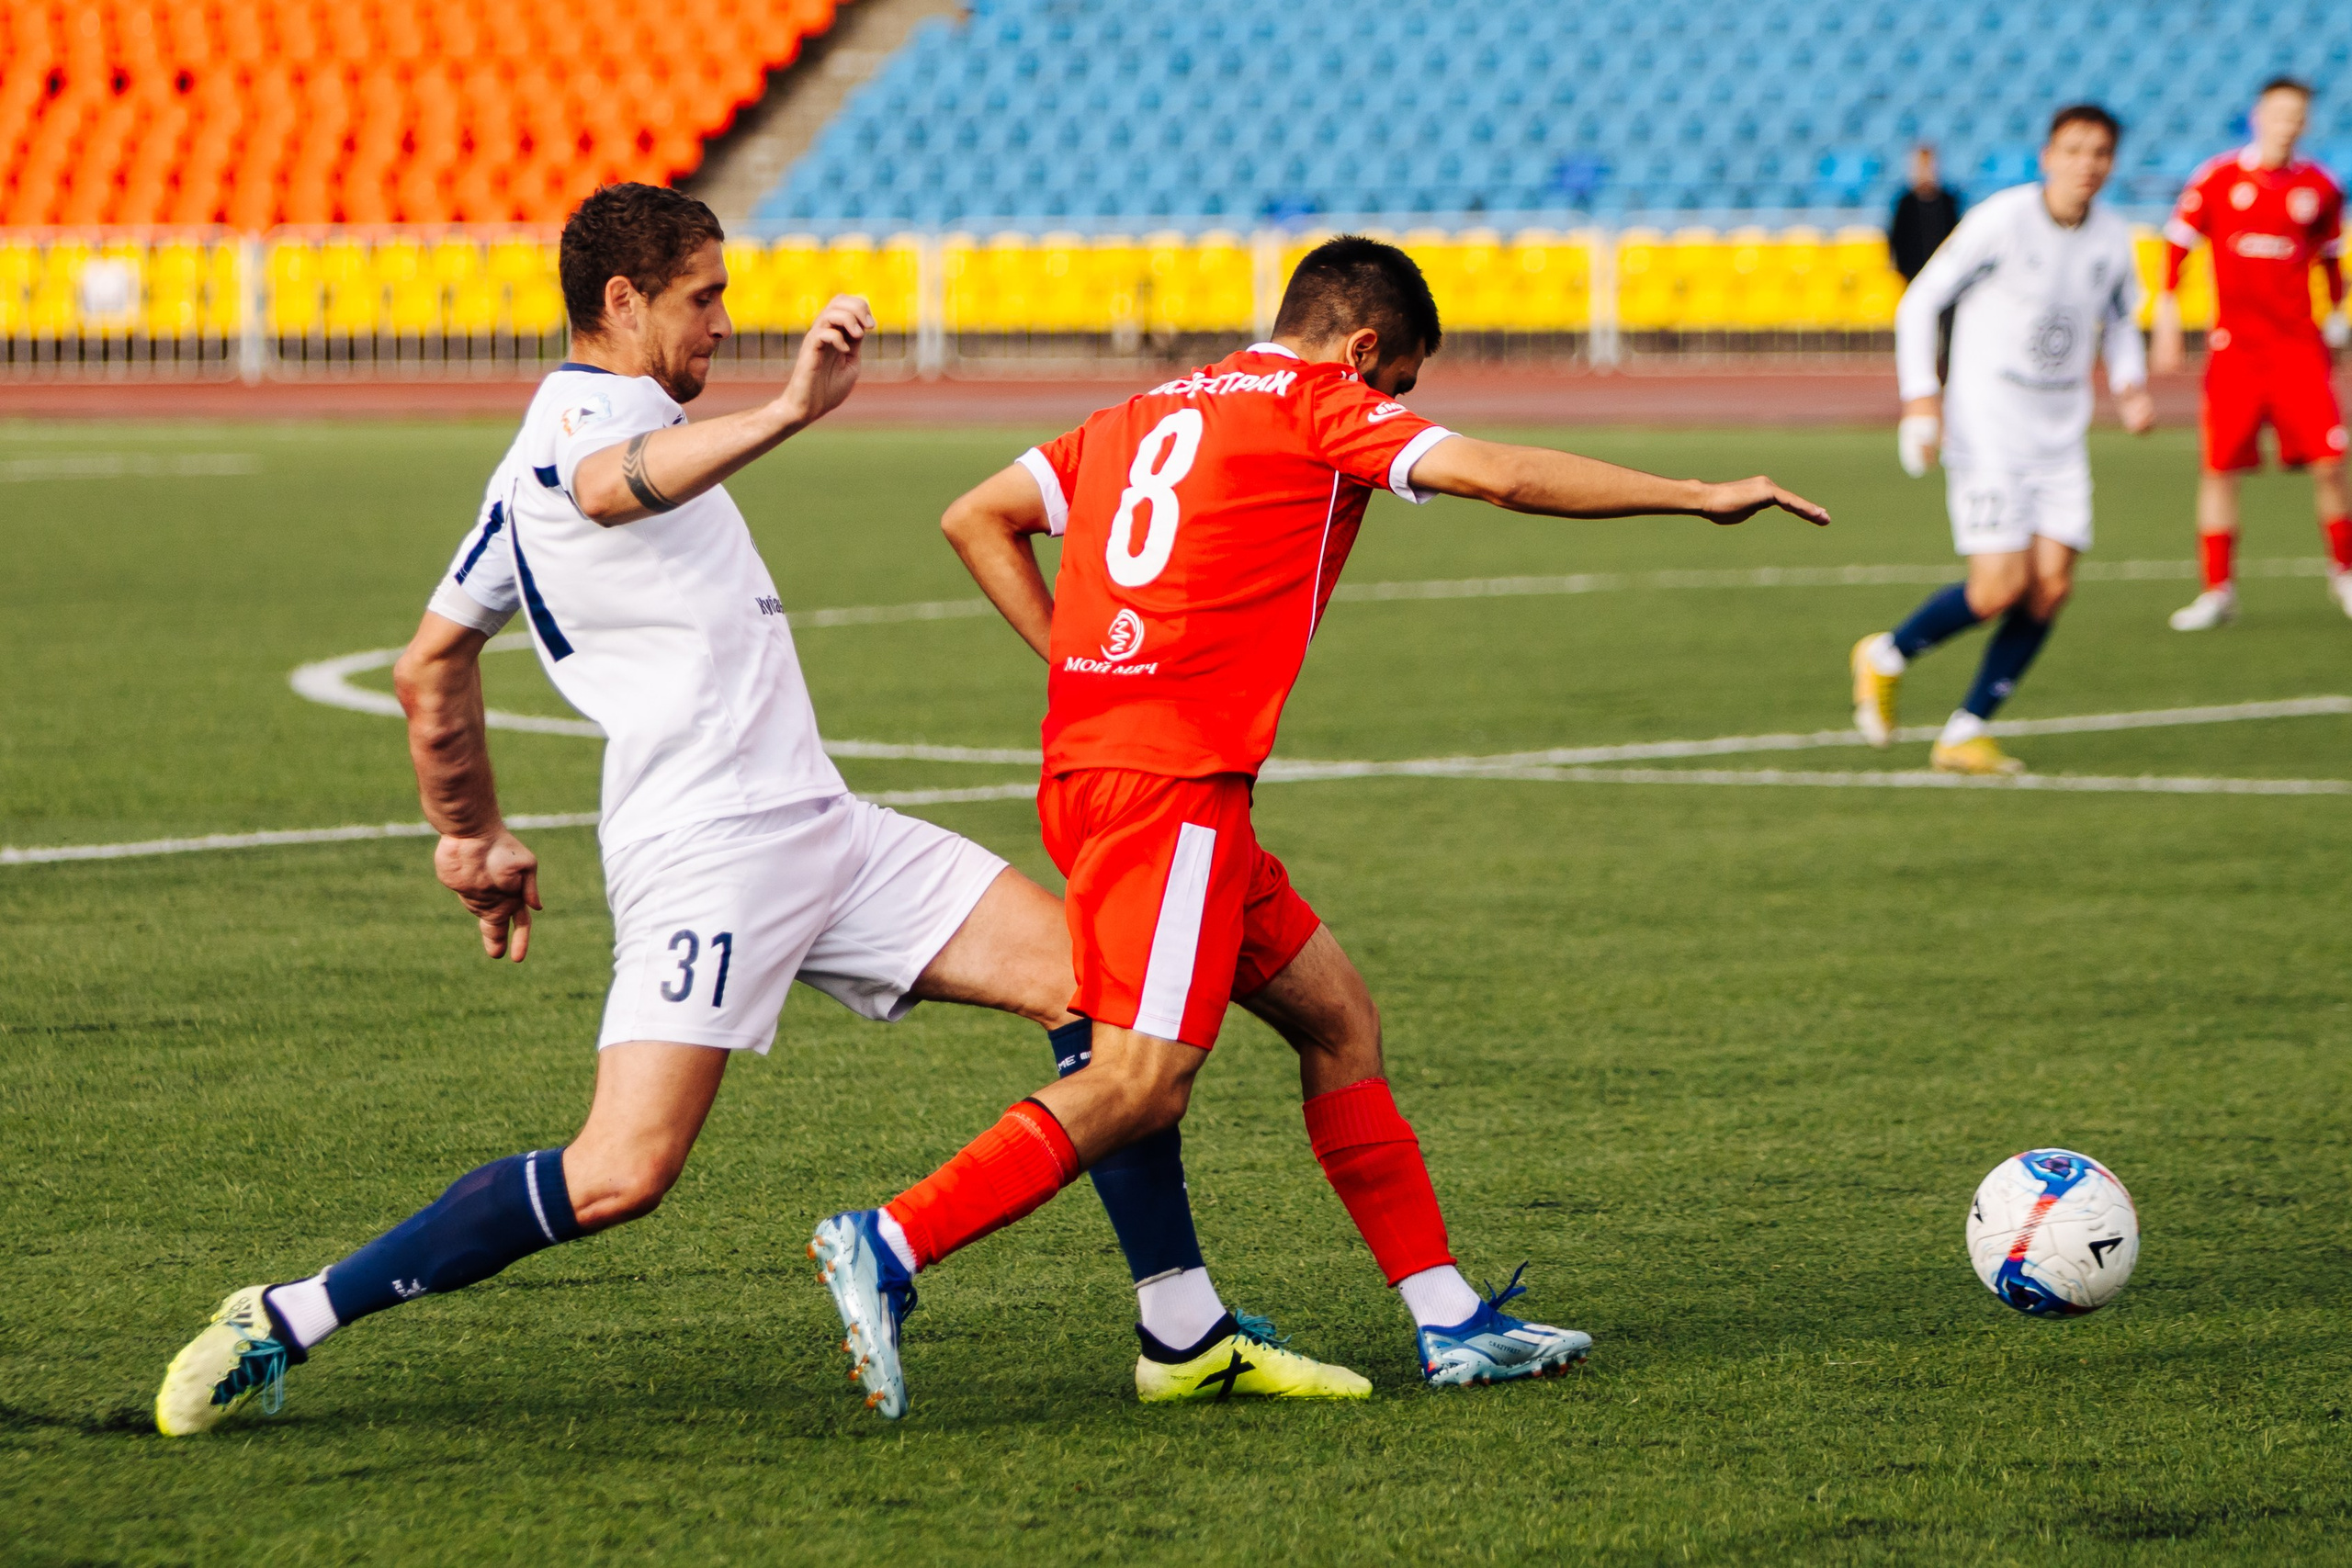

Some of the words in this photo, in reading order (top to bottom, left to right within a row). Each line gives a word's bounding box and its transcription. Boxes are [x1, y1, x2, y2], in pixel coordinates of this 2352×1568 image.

[1105, 408, 1203, 588] 8
[1064, 656, 1112, 673] МОЙ
[661, 929, 733, 1009] 31
